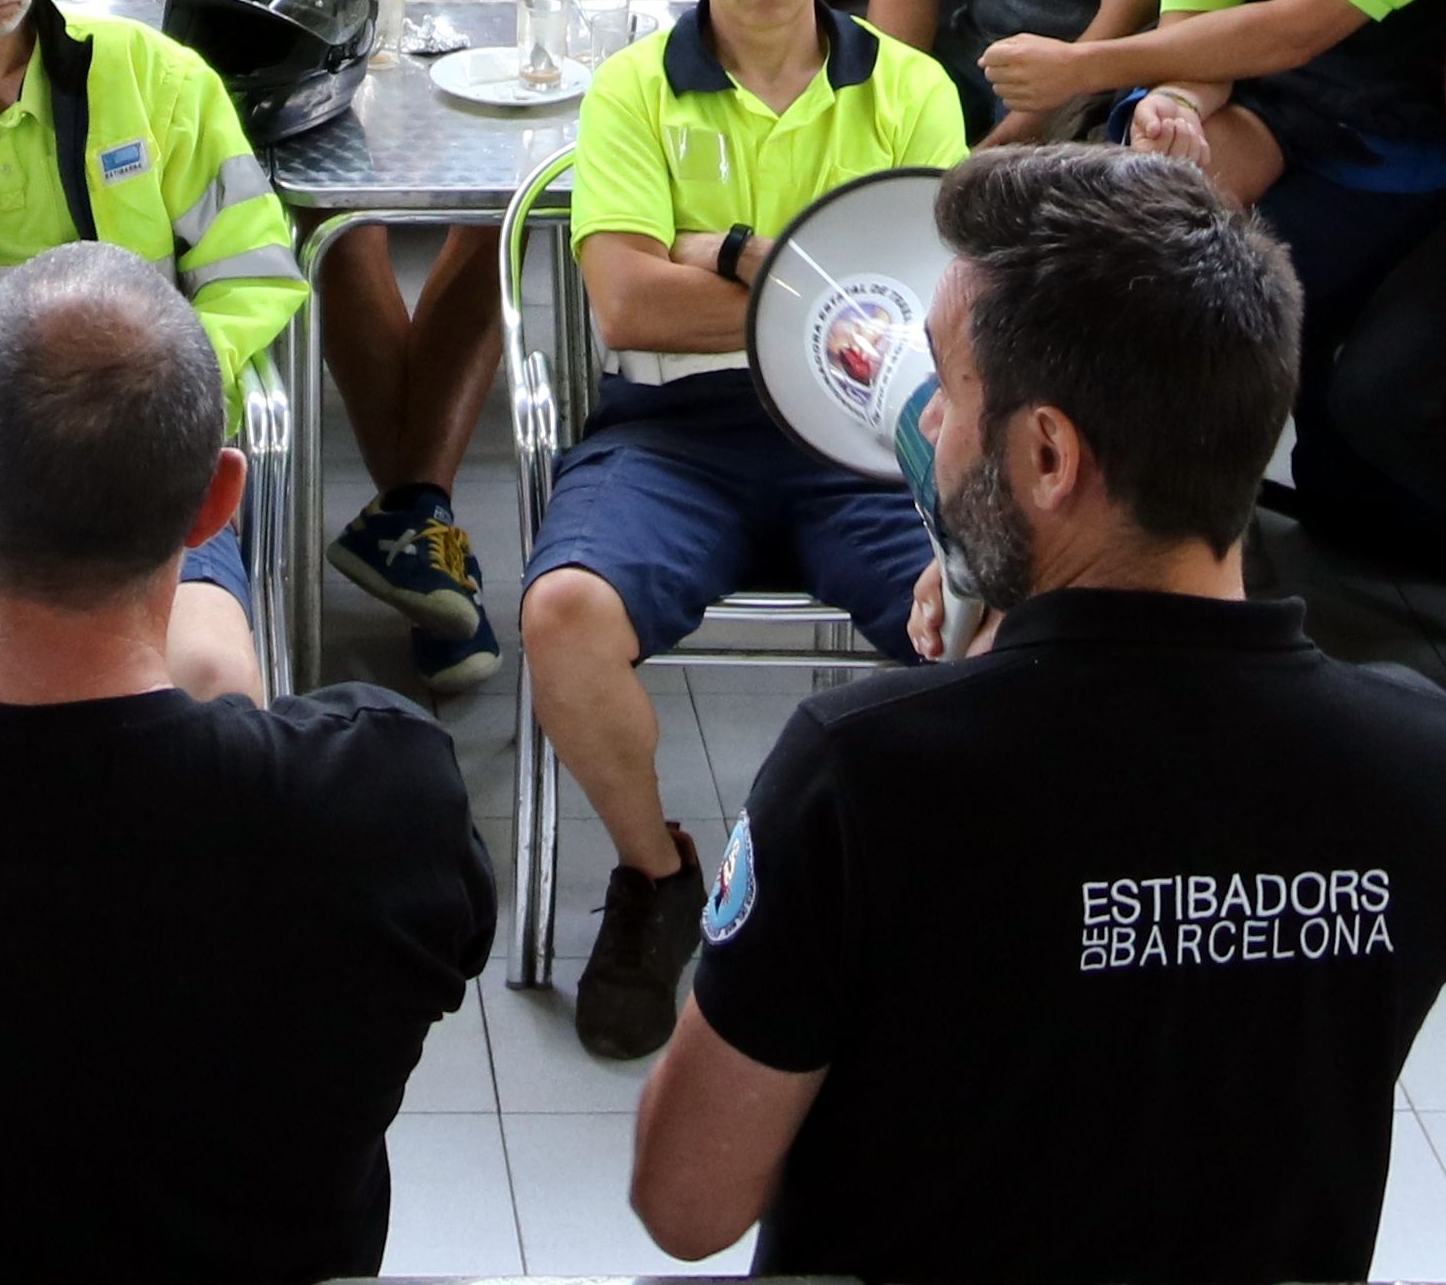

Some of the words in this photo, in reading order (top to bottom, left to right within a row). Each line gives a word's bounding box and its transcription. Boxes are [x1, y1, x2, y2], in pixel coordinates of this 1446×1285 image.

[1081, 868, 1390, 926] ESTIBADORS
[1080, 927, 1109, 972] DE
[1110, 914, 1395, 968] BARCELONA
